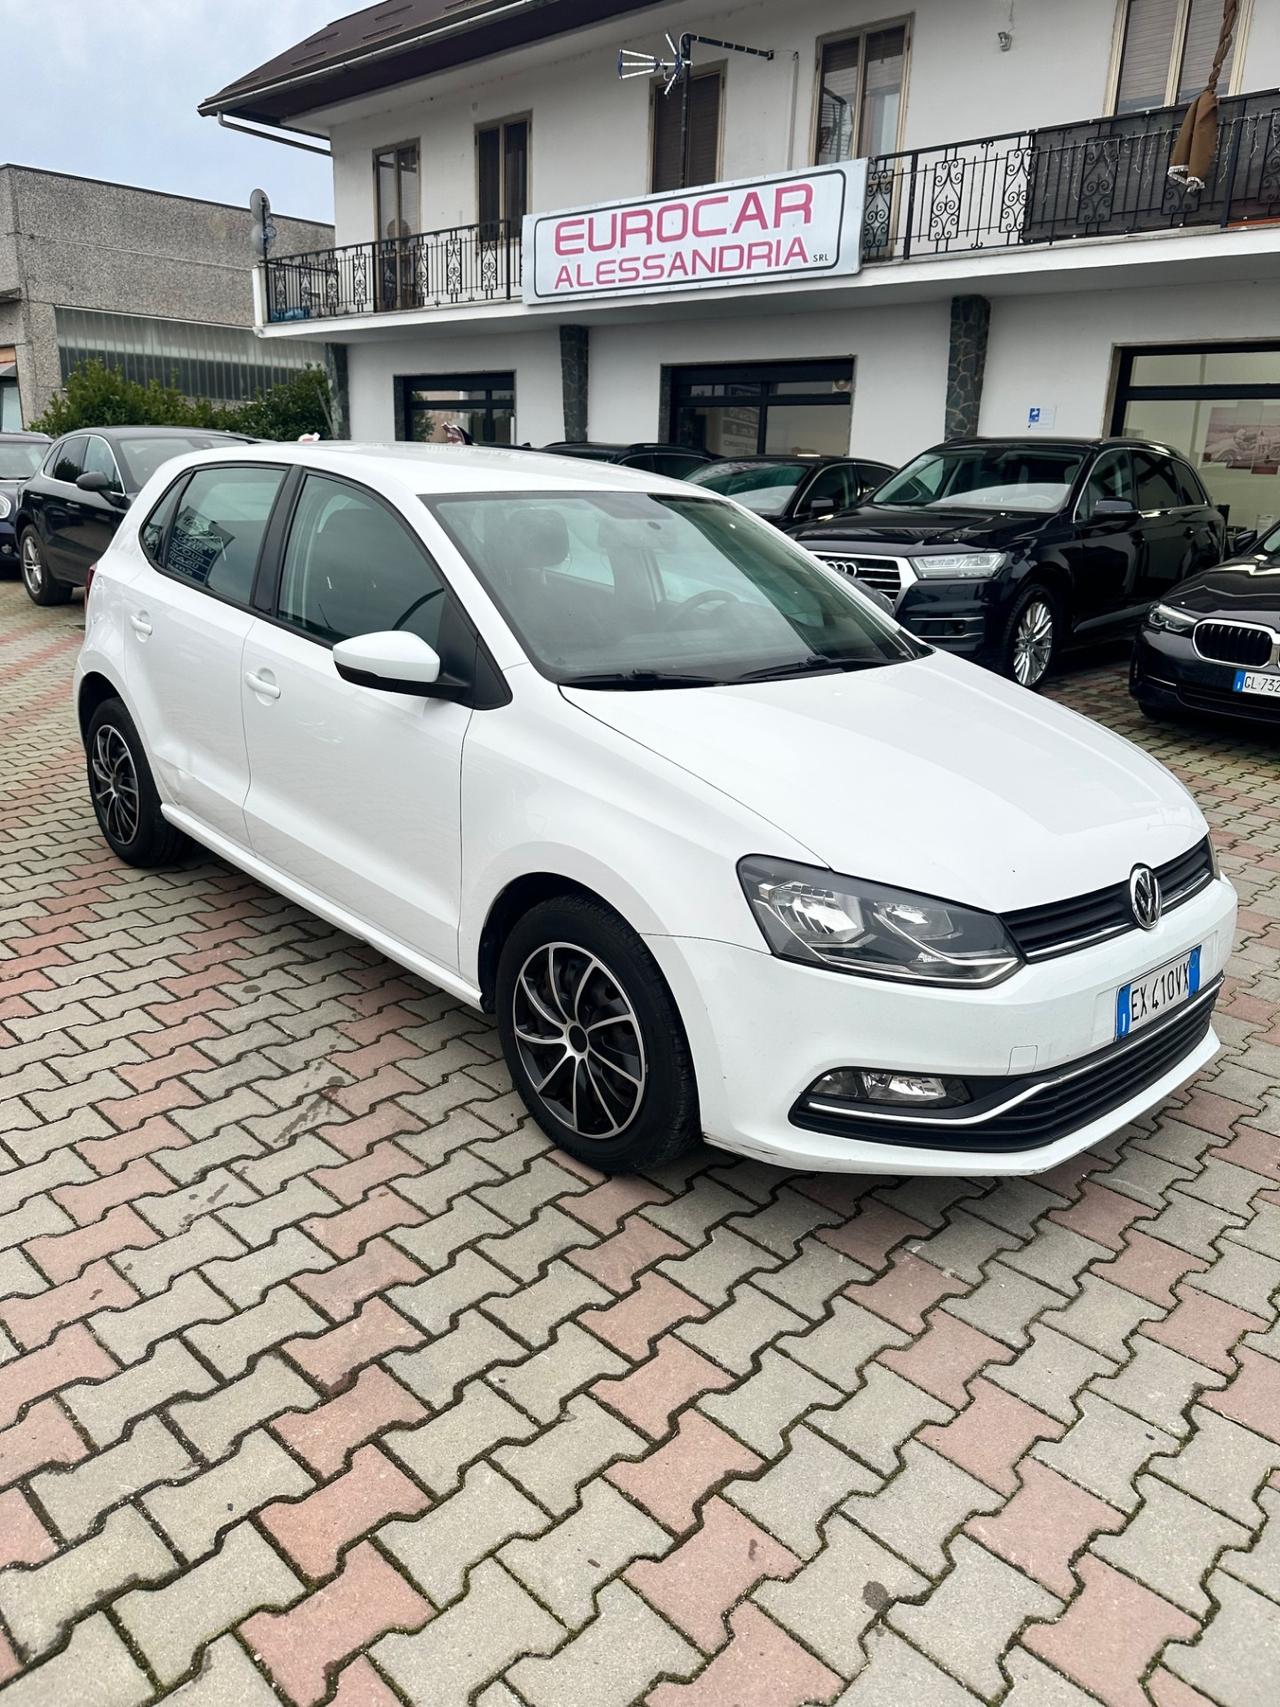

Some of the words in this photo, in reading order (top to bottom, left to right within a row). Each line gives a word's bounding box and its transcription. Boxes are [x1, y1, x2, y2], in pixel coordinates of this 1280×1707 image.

[554, 182, 814, 257] EUROCAR
[554, 236, 809, 290] ALESSANDRIA
[812, 253, 829, 263] SRL
